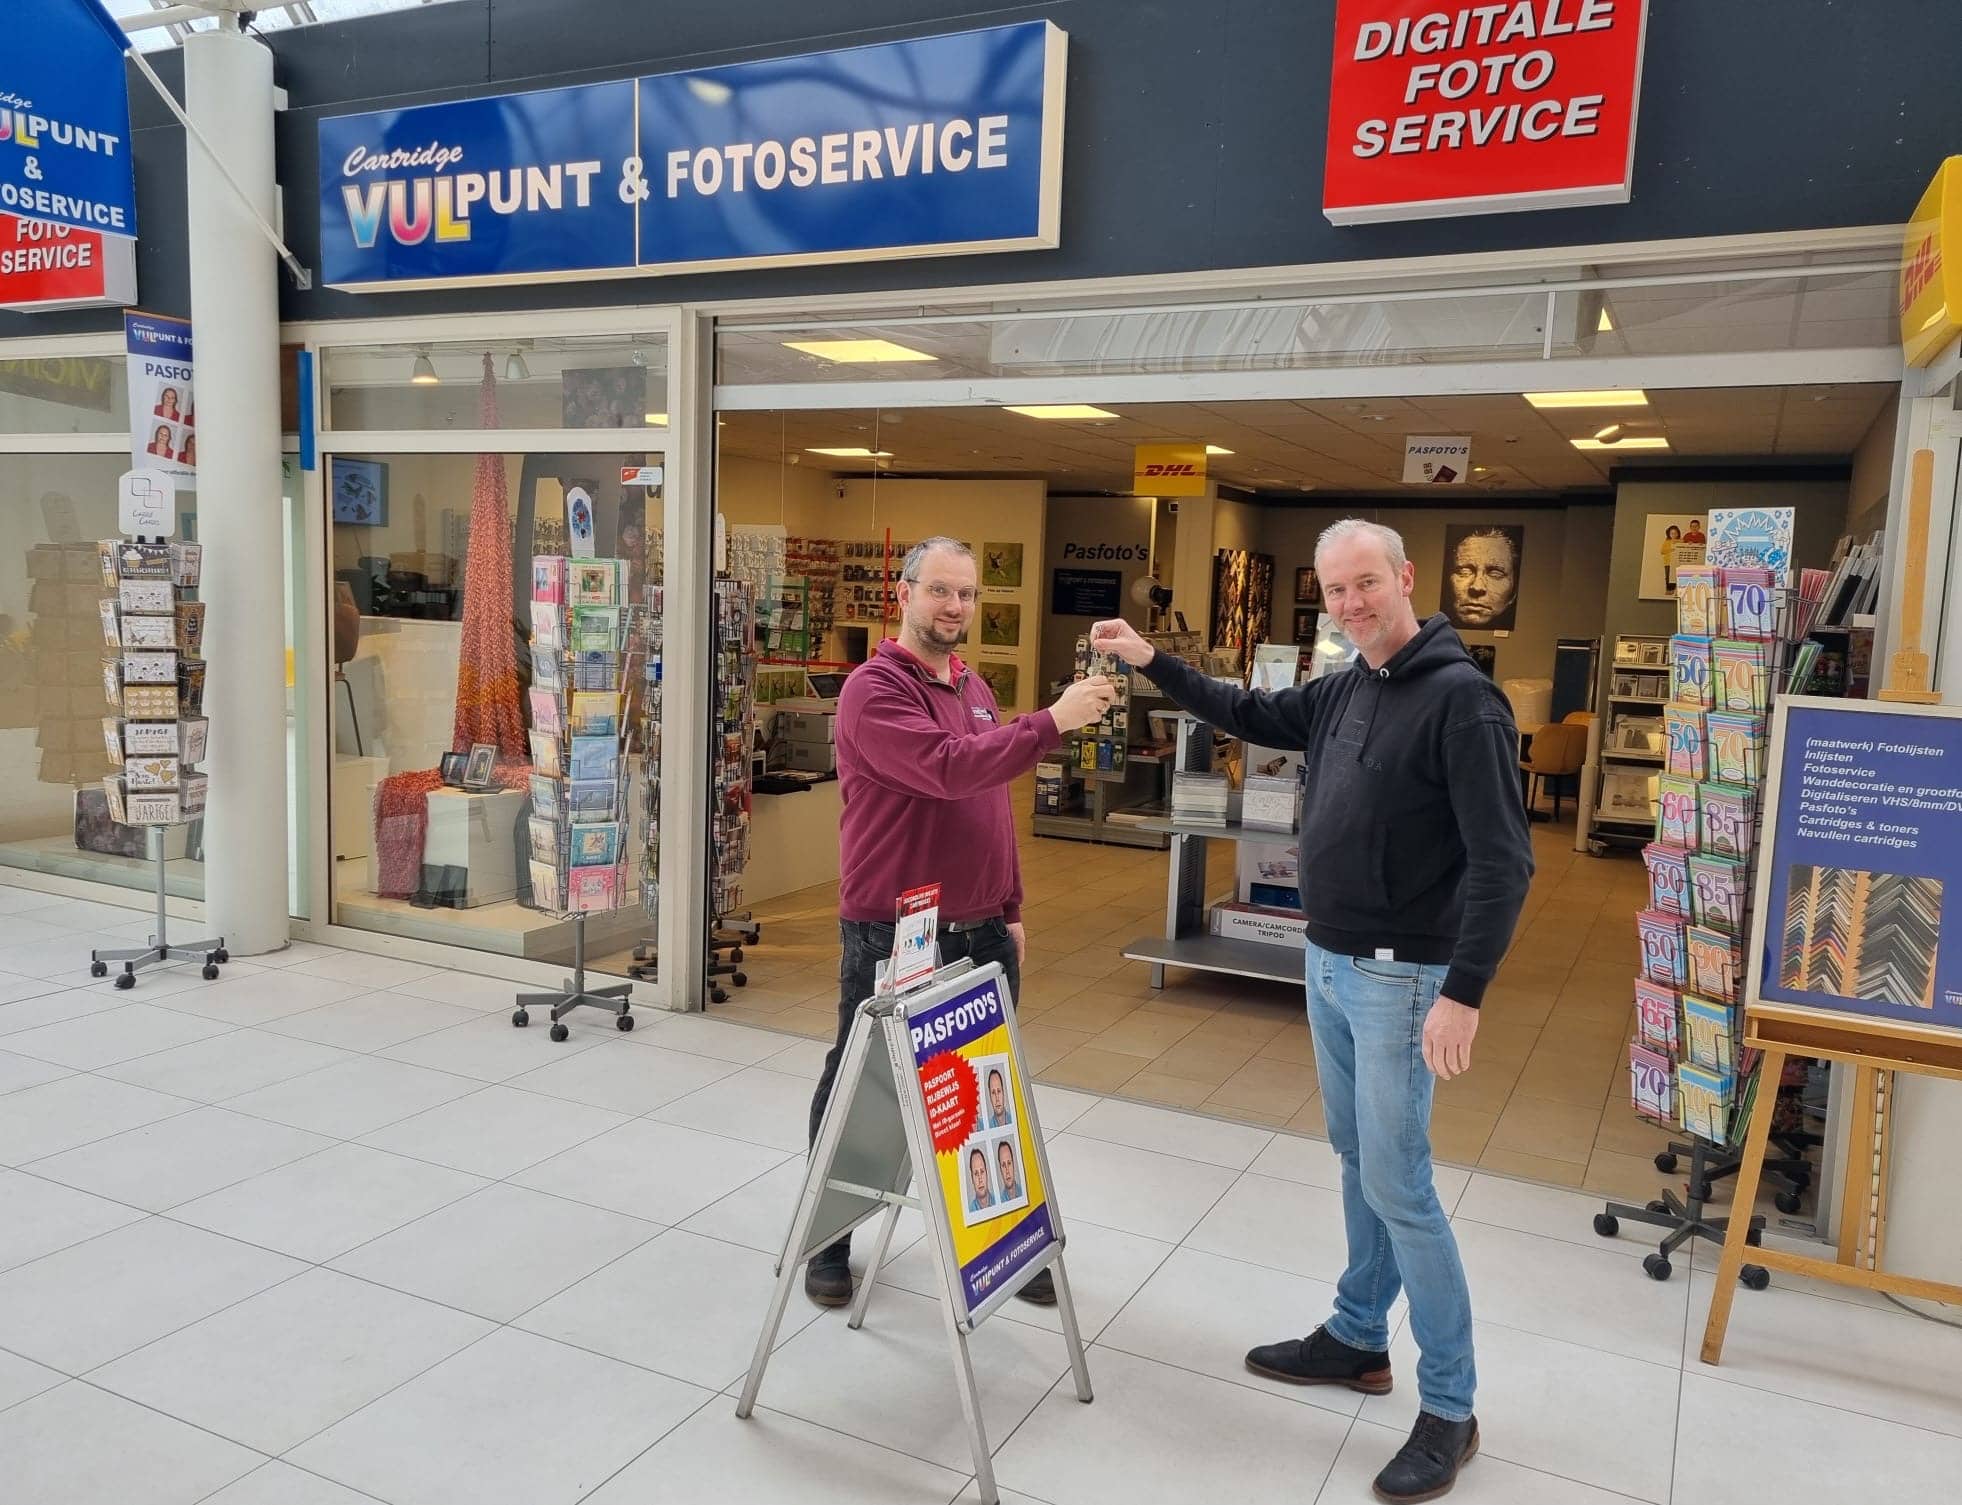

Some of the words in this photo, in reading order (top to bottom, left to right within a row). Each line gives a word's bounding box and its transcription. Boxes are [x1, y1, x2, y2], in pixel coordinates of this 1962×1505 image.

[1353, 0, 1614, 61] DIGITALE
[1403, 49, 1555, 105] FOTO
[1352, 94, 1603, 159] SERVICE
[24, 156, 43, 180] &
[343, 141, 463, 177] Cartridge
[619, 156, 650, 204] &
[667, 115, 1008, 198] FOTOSERVICE
[1, 243, 91, 274] SERVICE
[145, 362, 193, 381] PASFO
[1408, 446, 1468, 455] PASFOTO'S
[1145, 465, 1196, 476] DHL
[1064, 543, 1148, 560] Pasfoto's
[1730, 584, 1765, 616] 70
[1677, 654, 1706, 685] 50
[1720, 661, 1753, 689] 70
[1670, 723, 1699, 753] 50
[1715, 731, 1748, 761] 70
[1806, 737, 1873, 752] (maatwerk)
[1877, 742, 1944, 757] Fotolijsten
[1804, 763, 1876, 778] Fotoservice
[1805, 750, 1853, 763] Inlijsten
[1801, 789, 1878, 805] Digitaliseren
[1803, 776, 1895, 793] Wanddecoratie
[1898, 785, 1913, 794] en
[1663, 792, 1693, 823] 60
[1706, 803, 1739, 834] 85
[1800, 802, 1858, 815] Pasfoto's
[1797, 828, 1850, 841] Navullen
[1854, 833, 1917, 849] cartridges
[1799, 815, 1862, 830] Cartridges
[1866, 821, 1875, 830] &
[1879, 823, 1919, 835] toners
[1654, 862, 1684, 893] 60
[1697, 873, 1729, 905] 85
[1257, 930, 1285, 939] TRIPOD
[1644, 931, 1676, 961] 60
[911, 991, 997, 1052] PASFOTO'S
[1642, 997, 1673, 1030] 65
[924, 1068, 955, 1091] PASPOORT
[927, 1081, 960, 1105] RIJBEWIJS
[1635, 1061, 1665, 1095] 70
[930, 1096, 958, 1119] ID-KAART
[1011, 1226, 1045, 1261] FOTOSERVICE
